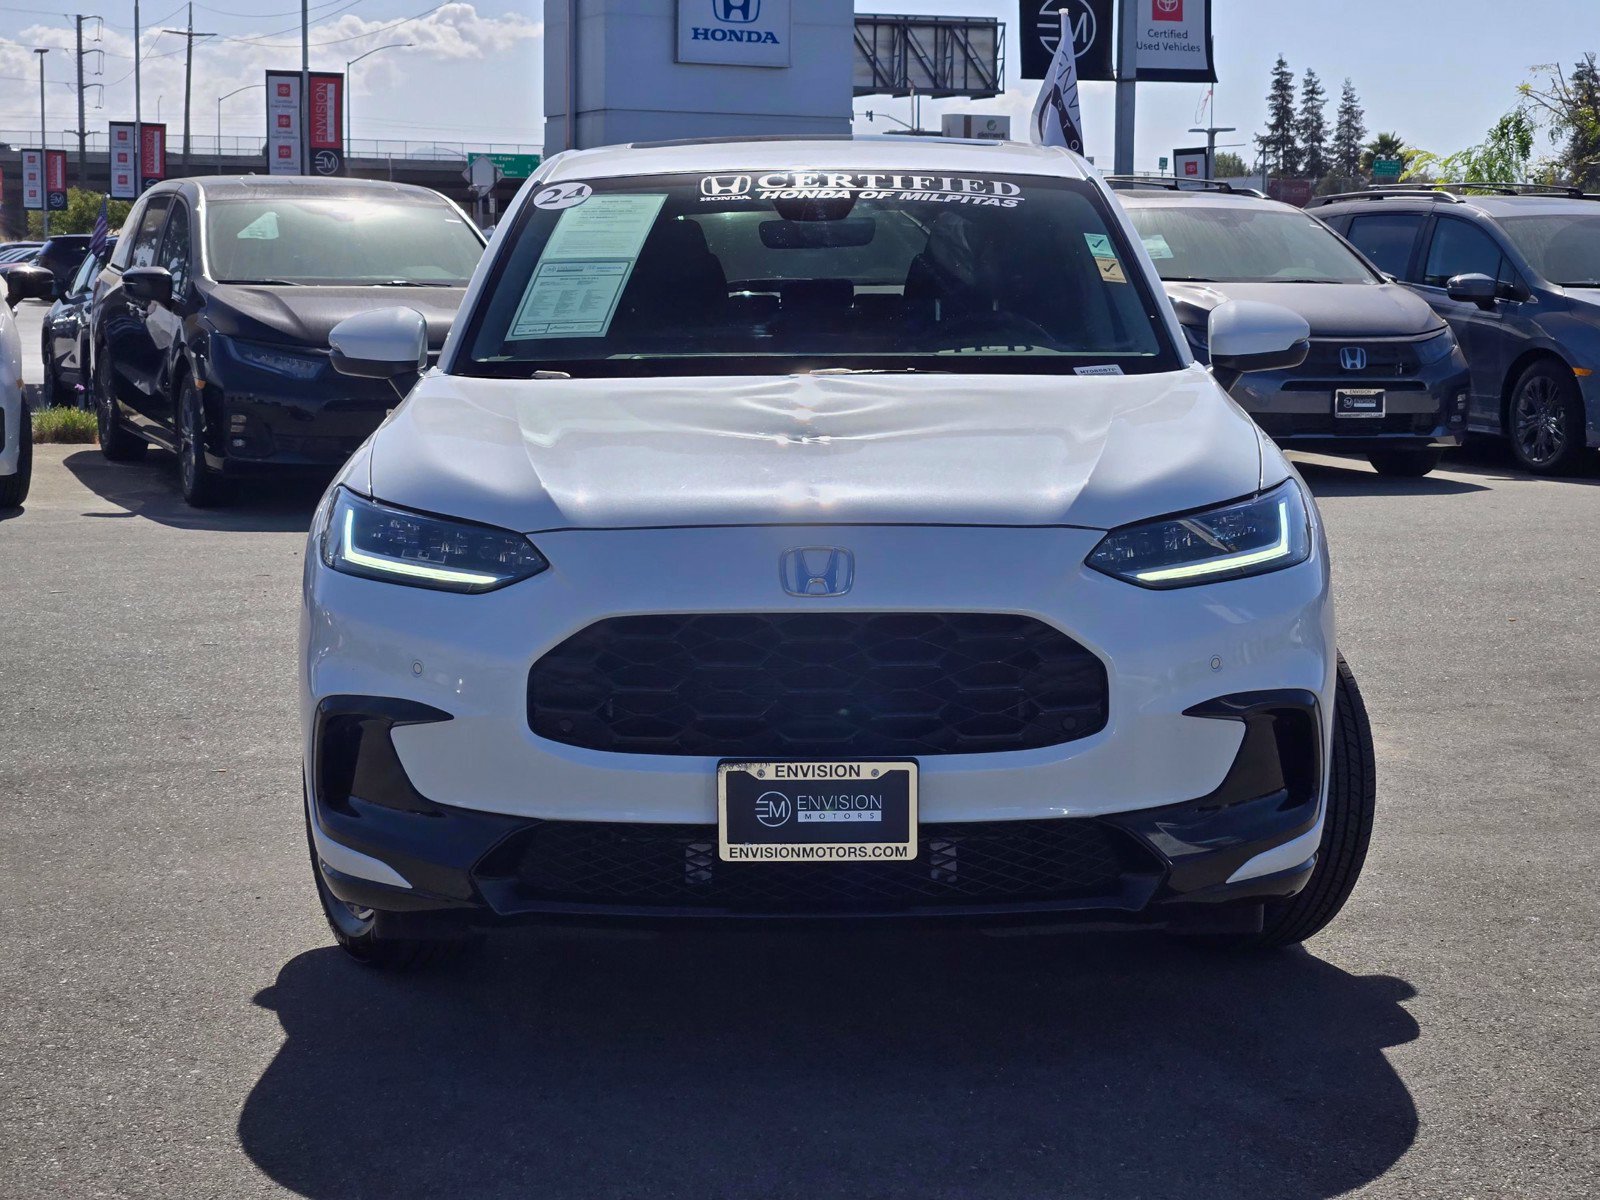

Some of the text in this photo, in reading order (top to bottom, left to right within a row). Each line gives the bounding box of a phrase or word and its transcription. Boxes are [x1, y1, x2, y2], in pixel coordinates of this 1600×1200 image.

[691, 27, 780, 44] HONDA
[1147, 28, 1188, 39] Certified
[1136, 41, 1201, 52] Used Vehicles
[316, 82, 327, 143] ENVISION
[757, 173, 1022, 197] CERTIFIED
[538, 185, 585, 206] 24
[759, 189, 1020, 209] HONDA OF MILPITAS
[775, 764, 861, 778] ENVISION
[797, 795, 882, 810] ENVISION
[804, 812, 875, 820] MOTORS
[729, 846, 908, 859] ENVISIONMOTORS.COM
